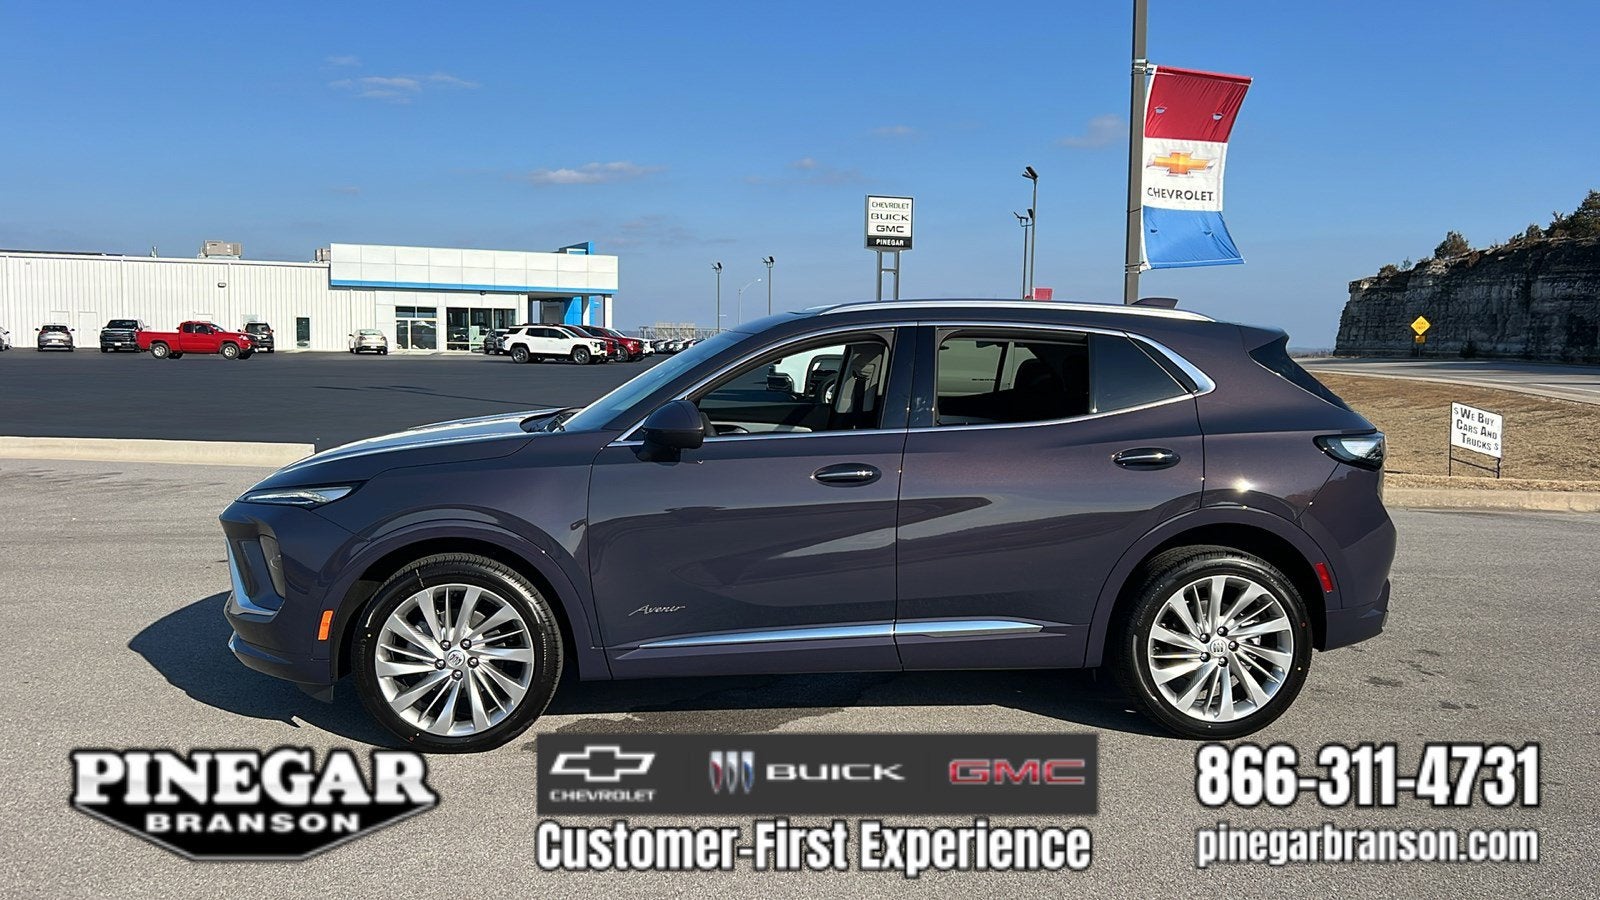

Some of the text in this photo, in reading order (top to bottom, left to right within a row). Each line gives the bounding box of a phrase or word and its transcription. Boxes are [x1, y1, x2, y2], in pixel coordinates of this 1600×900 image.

[1147, 187, 1213, 201] CHEVROLET
[871, 201, 910, 209] CHEVROLET
[870, 213, 910, 221] BUICK
[876, 225, 905, 233] GMC
